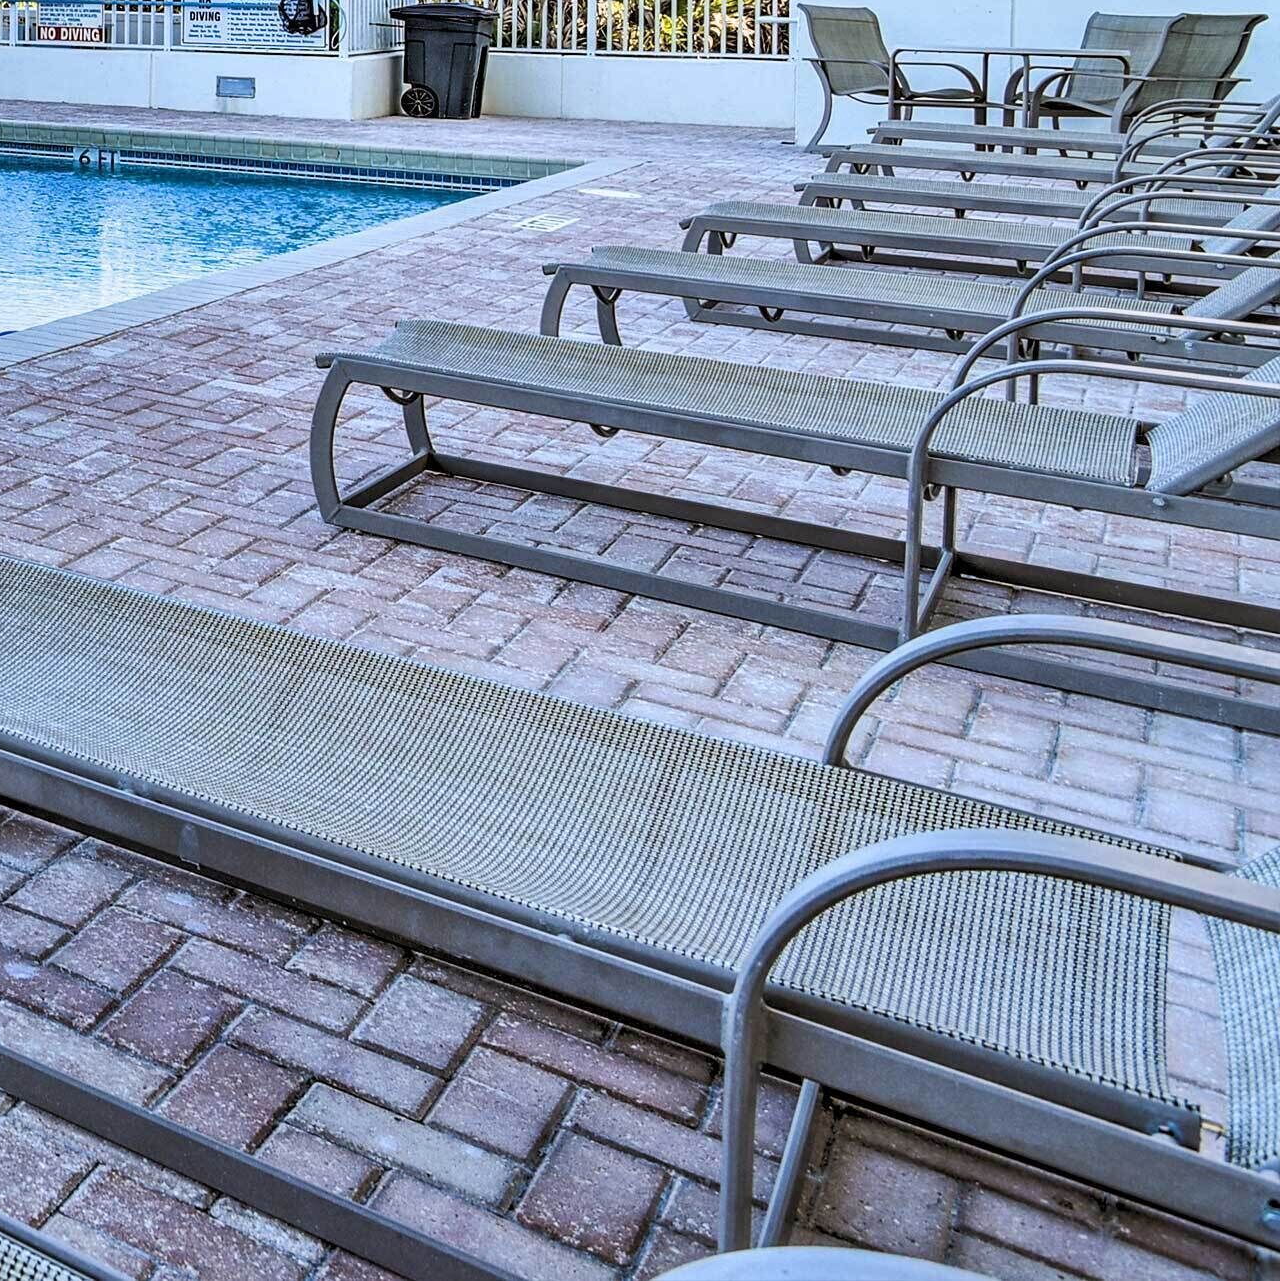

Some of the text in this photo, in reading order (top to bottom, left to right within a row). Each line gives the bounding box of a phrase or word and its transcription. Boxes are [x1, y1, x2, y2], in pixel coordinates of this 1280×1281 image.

[198, 0, 212, 10] NO
[189, 11, 221, 22] DIVING
[40, 27, 100, 41] NO DIVING
[78, 148, 118, 168] 6 FT
